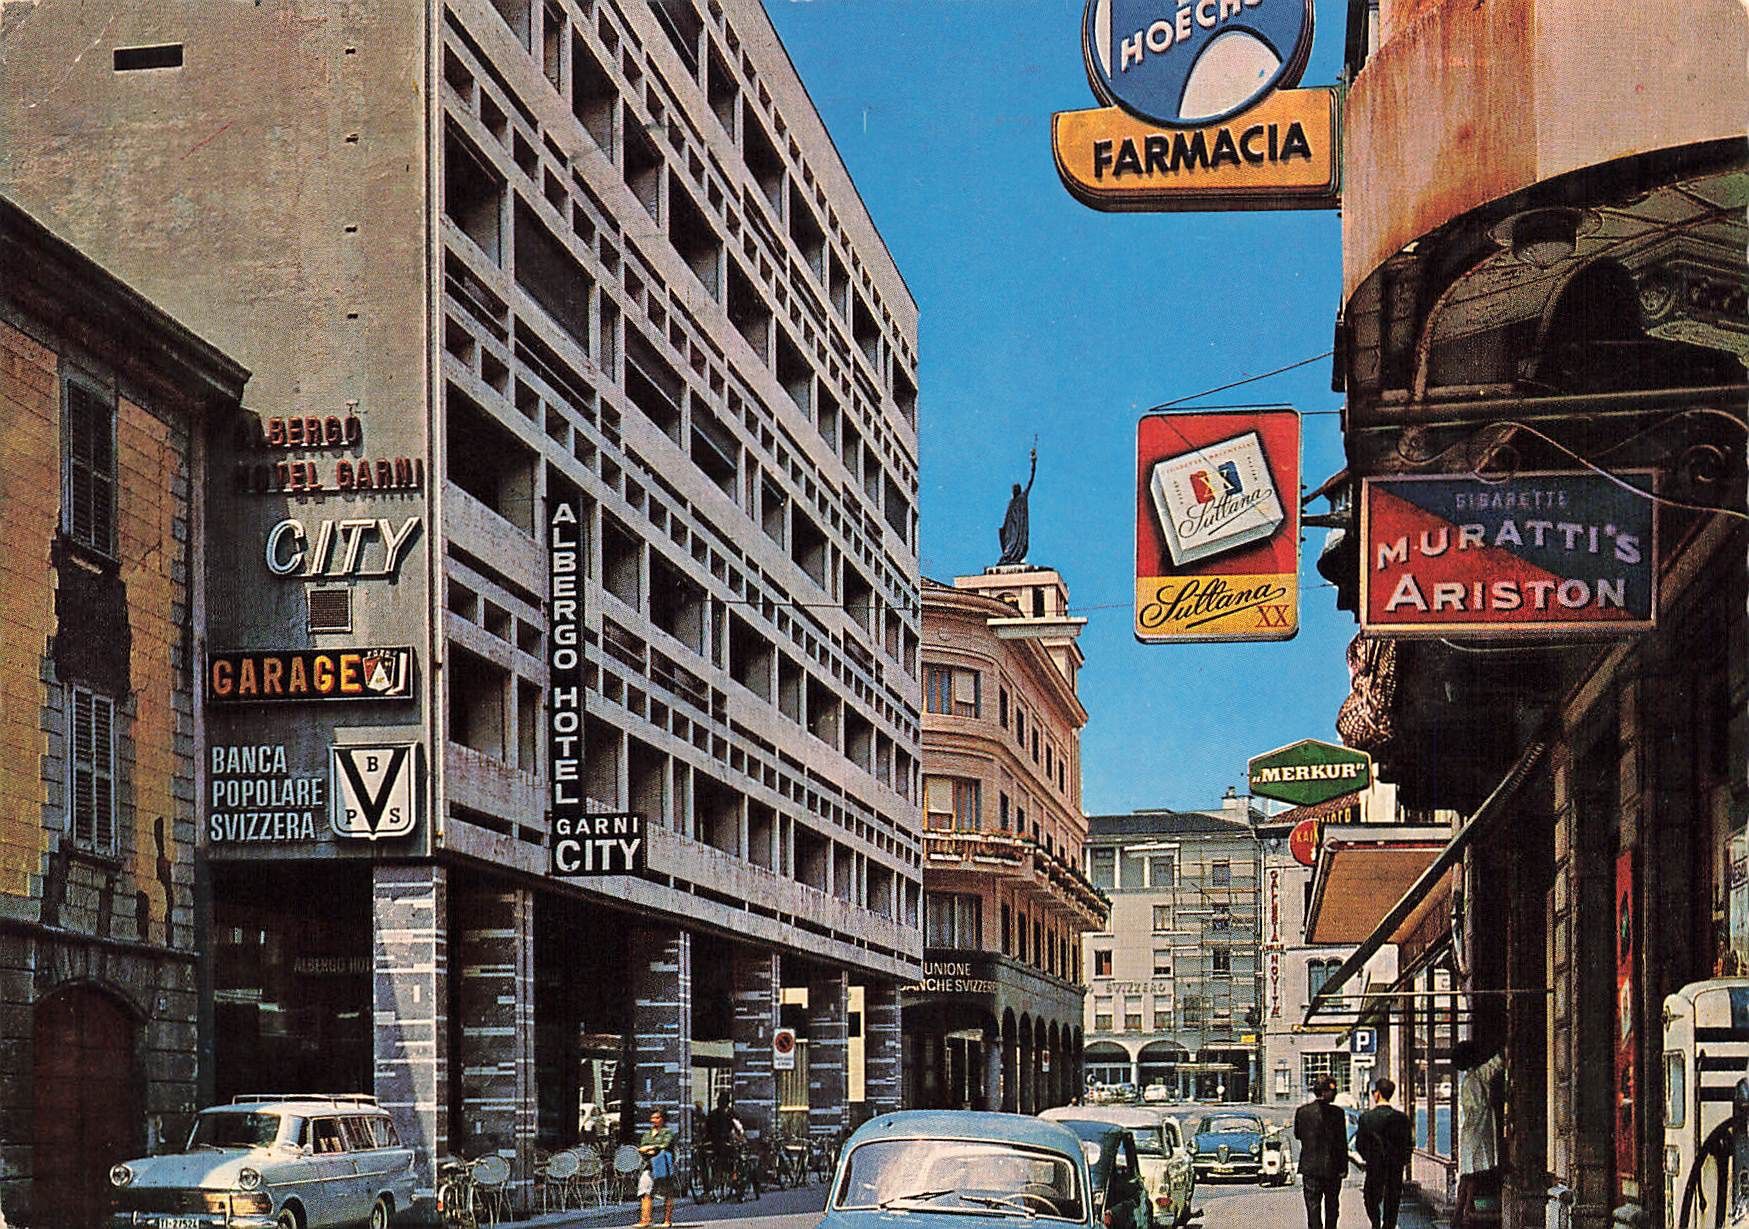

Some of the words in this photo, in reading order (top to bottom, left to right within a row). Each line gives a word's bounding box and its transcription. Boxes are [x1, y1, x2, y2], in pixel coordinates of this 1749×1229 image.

[1121, 0, 1263, 71] HOECH
[1092, 121, 1312, 178] FARMACIA
[336, 456, 425, 489] GARNI
[266, 516, 421, 575] CITY
[1377, 519, 1642, 570] MURATTI'S
[552, 503, 578, 670] ALBERGO
[1385, 573, 1626, 612] ARISTON
[1139, 578, 1287, 629] Sultana
[1255, 604, 1290, 627] XX
[213, 654, 363, 697] GARAGE
[211, 745, 288, 774] BANCA
[553, 686, 579, 804] HOTEL
[366, 756, 378, 772] B
[212, 778, 324, 808] POPOLARE
[210, 811, 316, 841] SVIZZERA
[345, 809, 357, 825] P
[389, 808, 401, 824] S
[556, 816, 639, 836] GARNI
[556, 838, 642, 872] CITY
[924, 962, 971, 976] UNIONE
[1356, 1031, 1370, 1052] P
